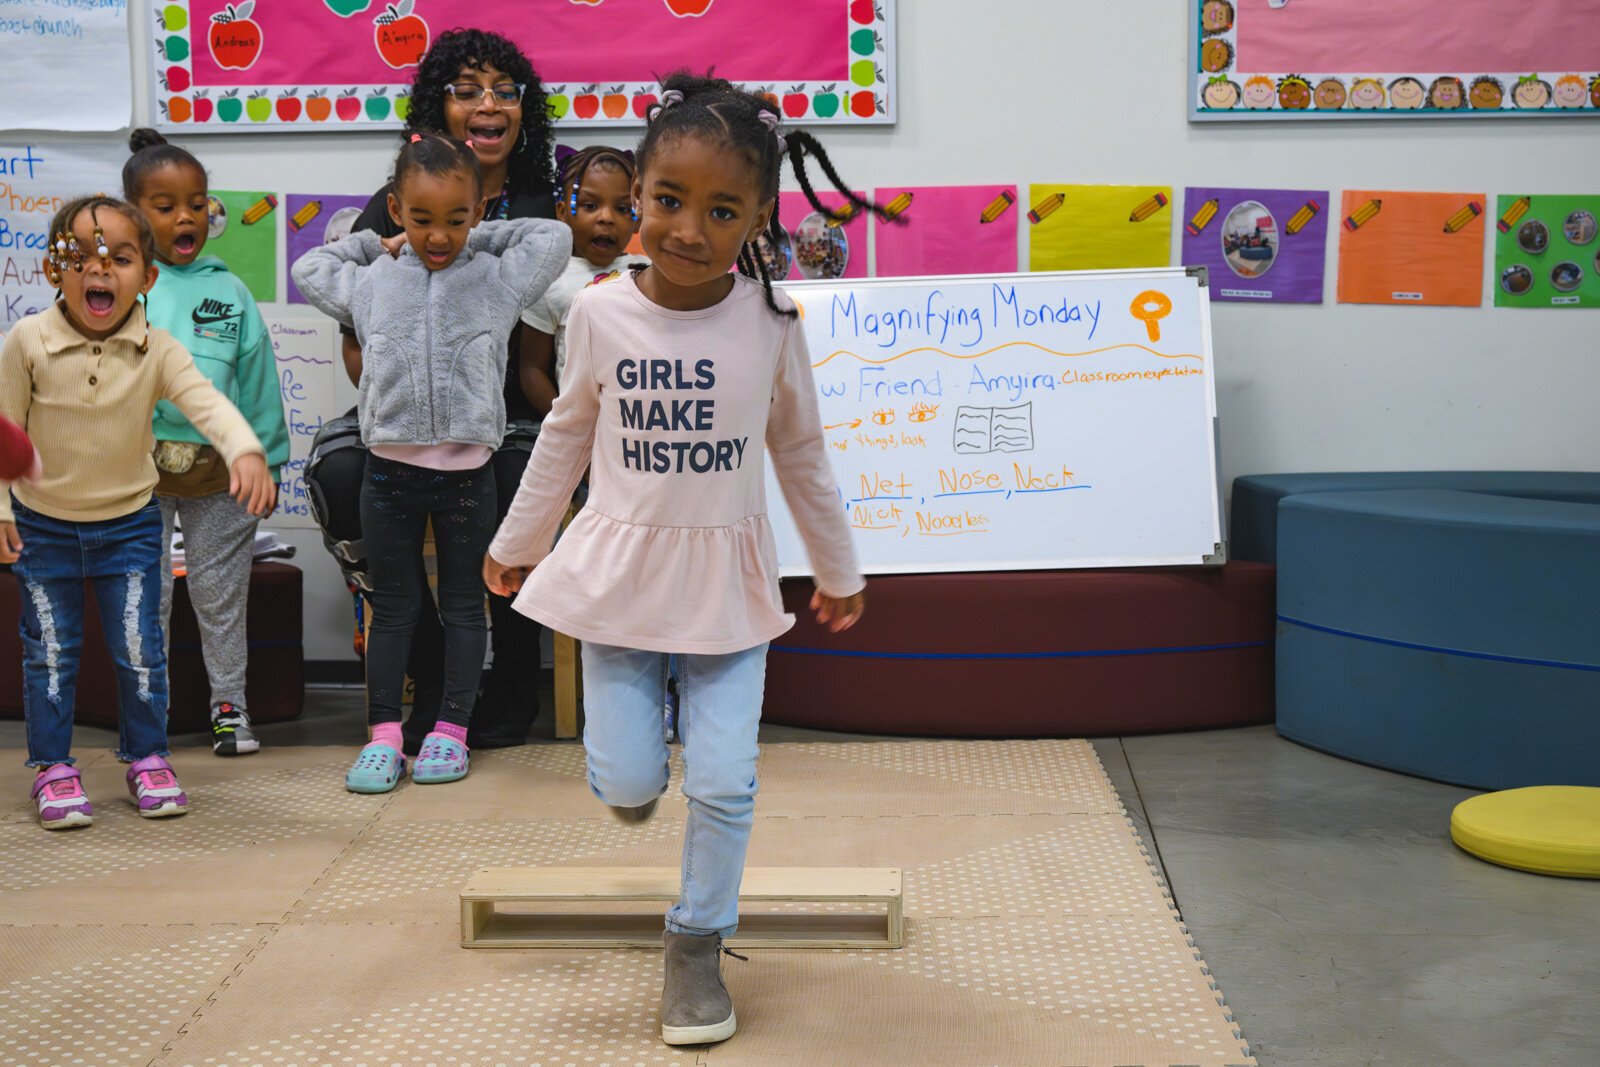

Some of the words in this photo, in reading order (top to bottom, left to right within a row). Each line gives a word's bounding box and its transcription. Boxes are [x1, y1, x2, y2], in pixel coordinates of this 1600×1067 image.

[198, 298, 235, 316] NIKE
[832, 290, 983, 347] Magnifying
[993, 283, 1101, 340] Monday
[224, 321, 238, 332] 72
[616, 359, 716, 390] GIRLS
[859, 367, 942, 401] Friend
[619, 398, 715, 431] MAKE
[622, 437, 748, 473] HISTORY
[1013, 463, 1076, 490] Neck
